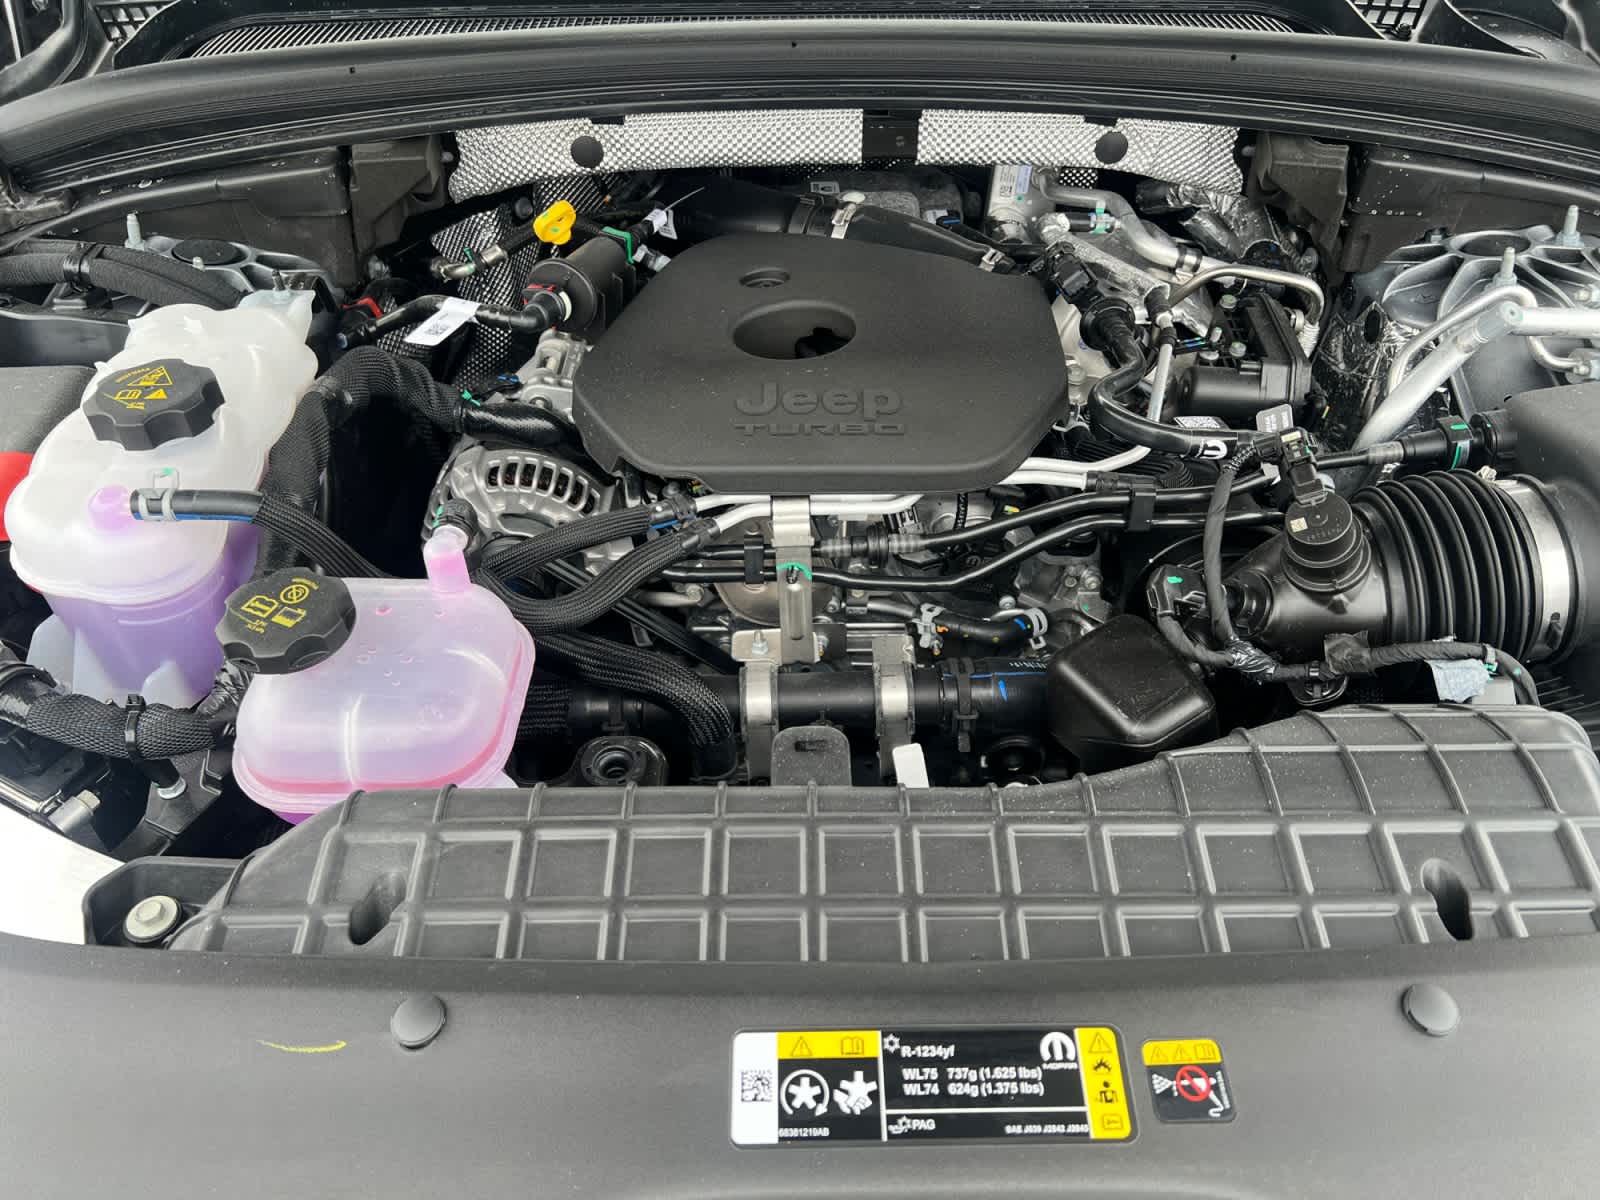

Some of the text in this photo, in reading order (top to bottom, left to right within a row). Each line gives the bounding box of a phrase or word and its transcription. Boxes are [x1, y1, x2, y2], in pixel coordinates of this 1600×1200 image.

[735, 382, 904, 421] Jeep
[734, 423, 905, 436] TURBO
[901, 1044, 955, 1060] R-1234yf
[902, 1066, 1042, 1082] WL75 737g (1.625 lbs)
[903, 1081, 1044, 1098] WL74 624g (1.375 lbs)
[912, 1119, 936, 1131] PAG
